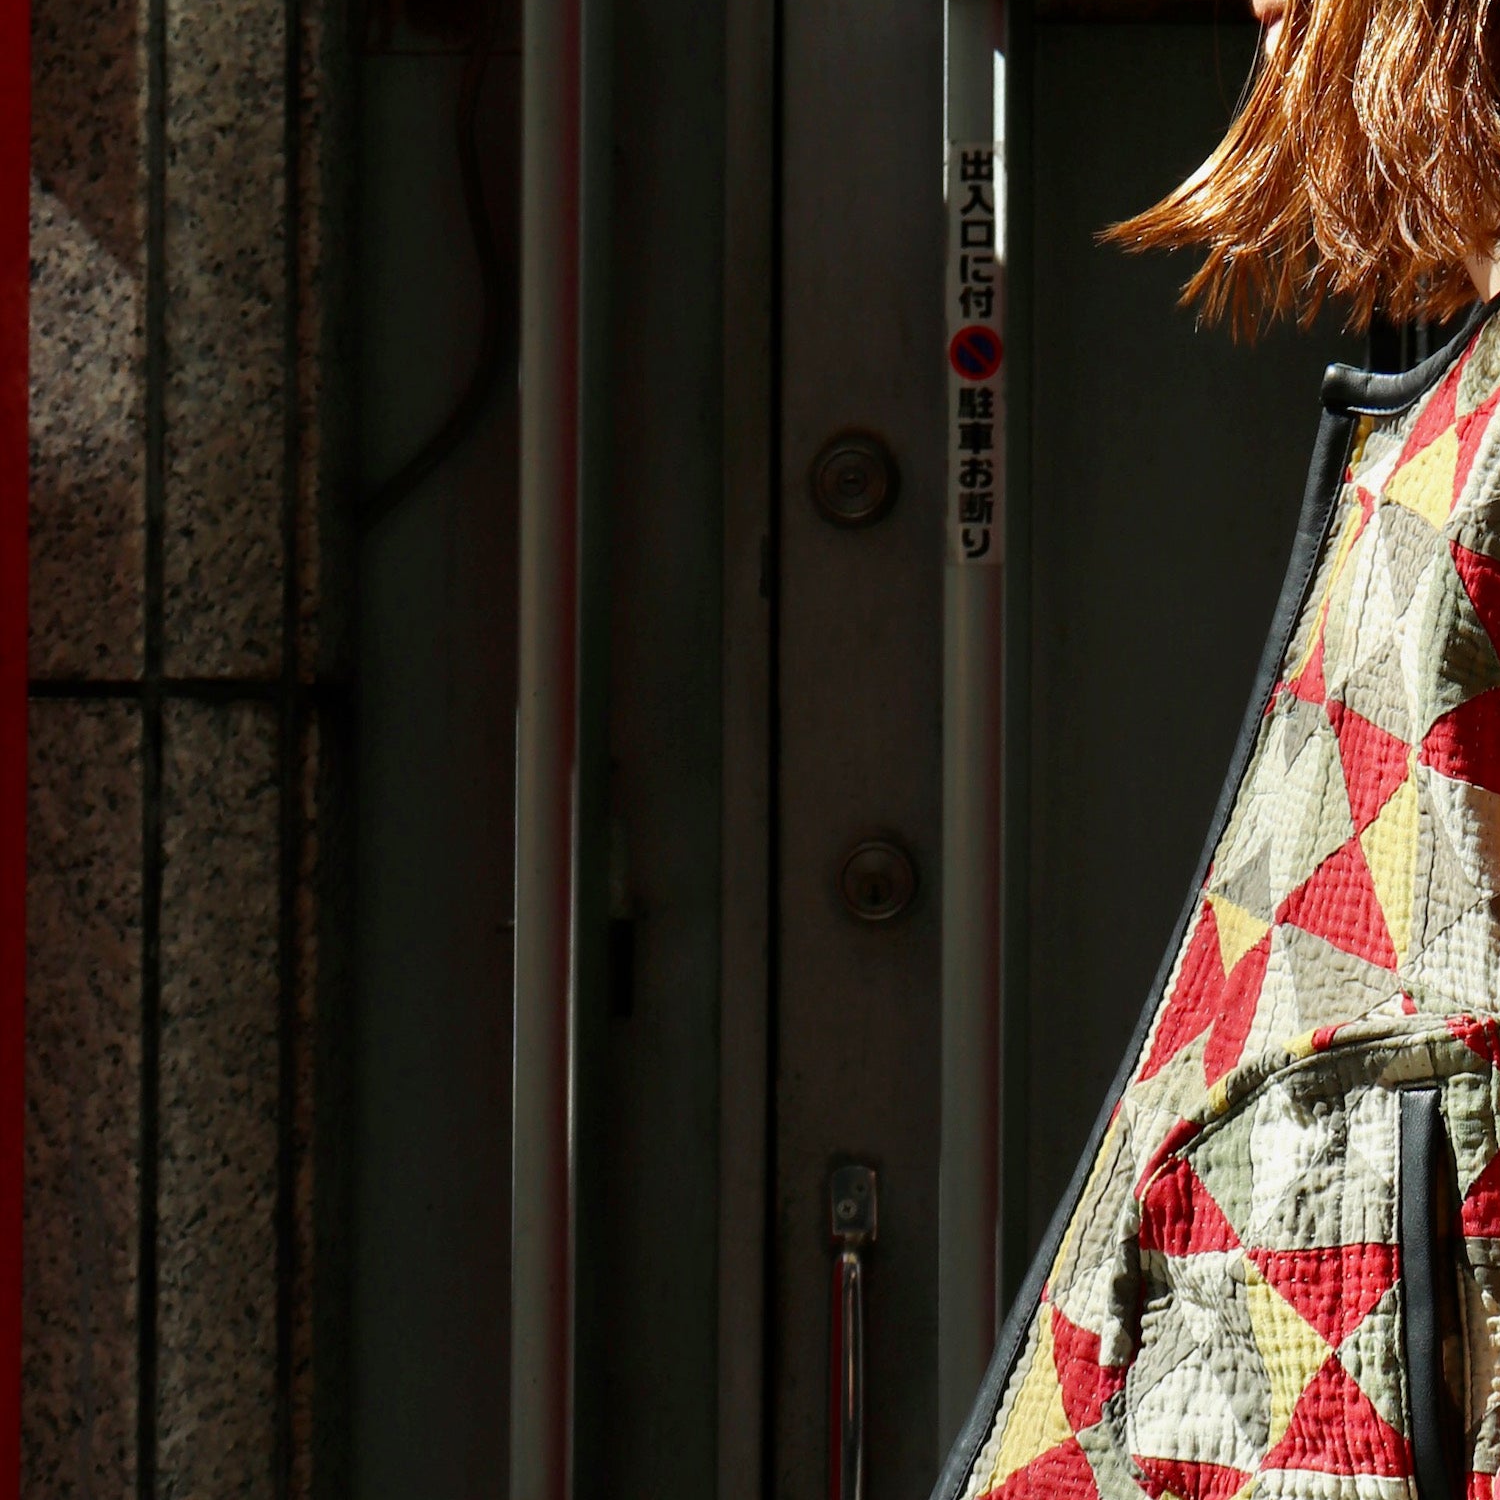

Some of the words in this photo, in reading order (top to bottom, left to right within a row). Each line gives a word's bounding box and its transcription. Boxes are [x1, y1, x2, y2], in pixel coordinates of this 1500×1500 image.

[958, 150, 994, 319] 出入口に付
[957, 387, 994, 559] 駐車お断り
